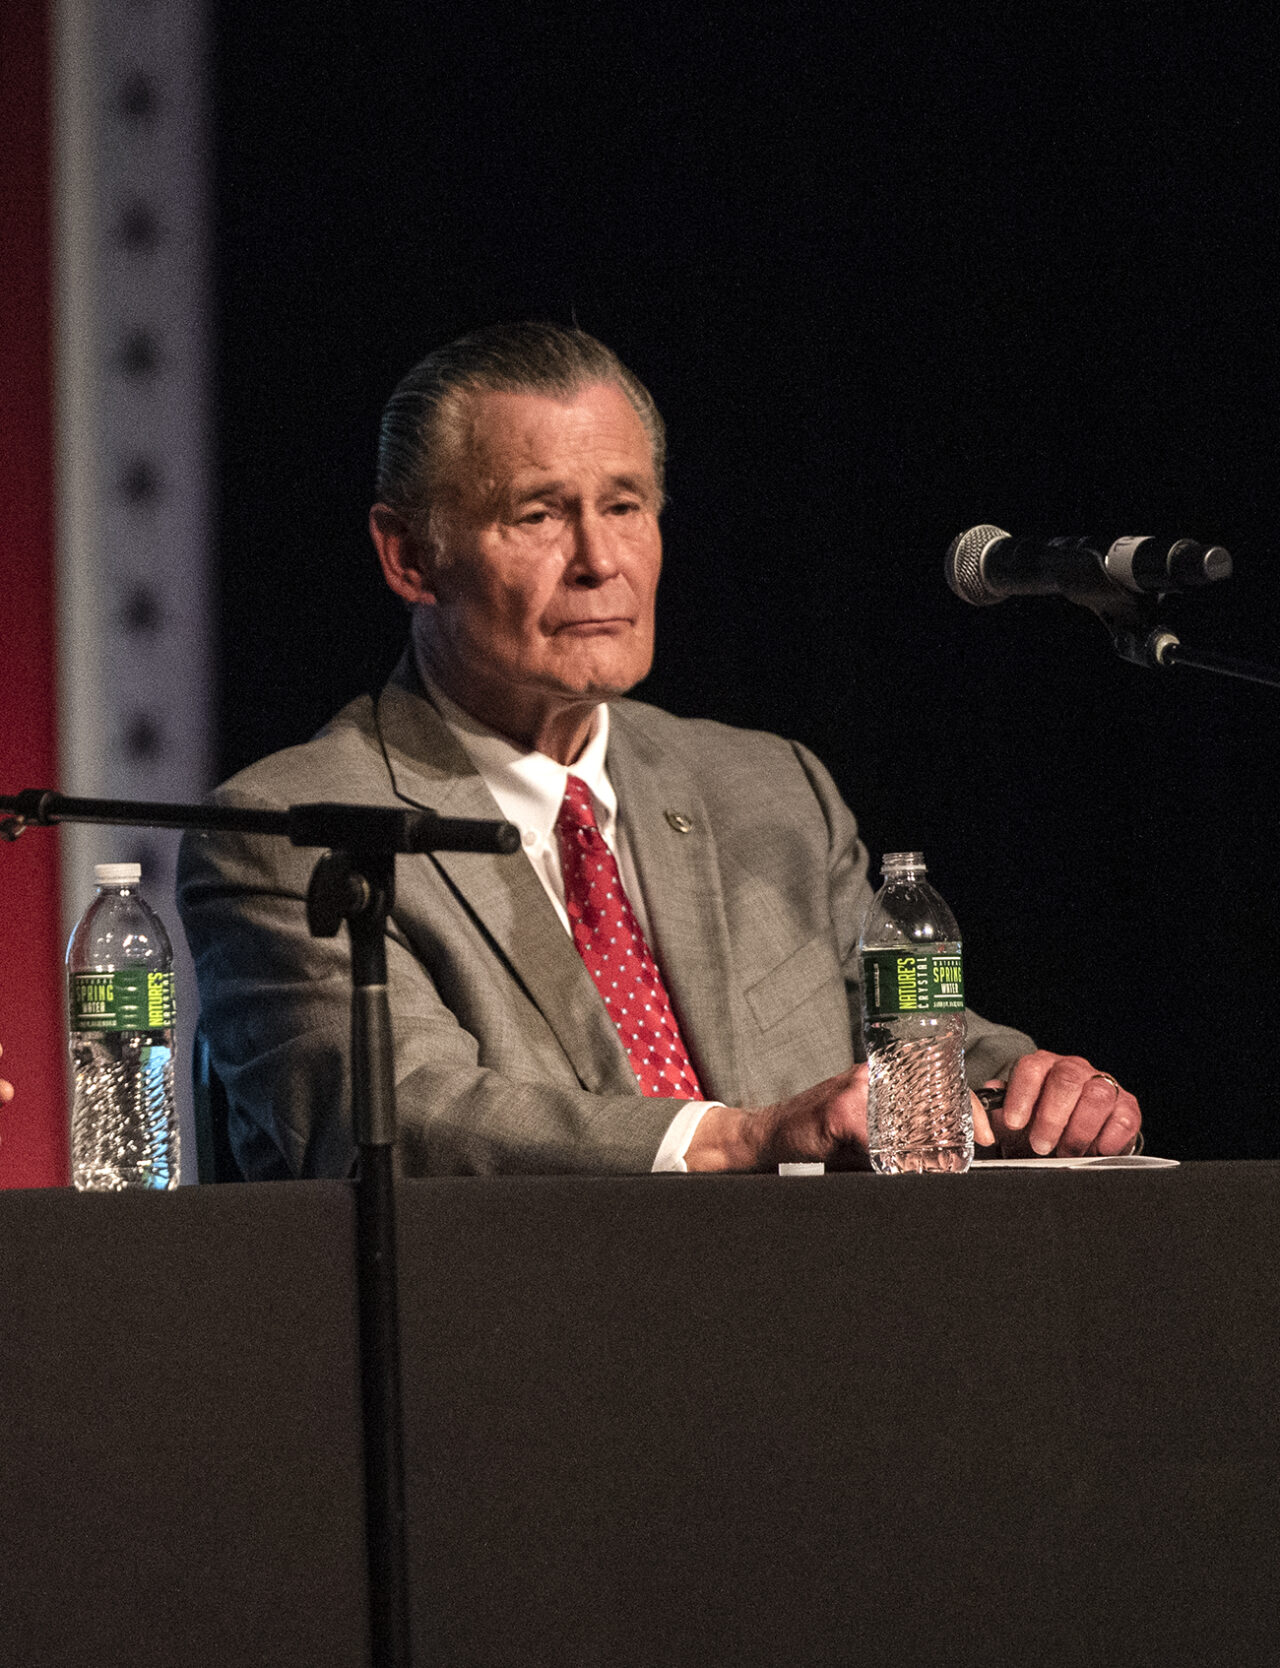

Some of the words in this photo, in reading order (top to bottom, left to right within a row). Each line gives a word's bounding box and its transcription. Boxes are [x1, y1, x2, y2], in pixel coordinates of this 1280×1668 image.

[148, 972, 163, 1027] NATURE'S
[897, 957, 917, 1009] NATURE'S
[917, 957, 929, 1008] CRYSTAL
[933, 967, 961, 983] SPRING
